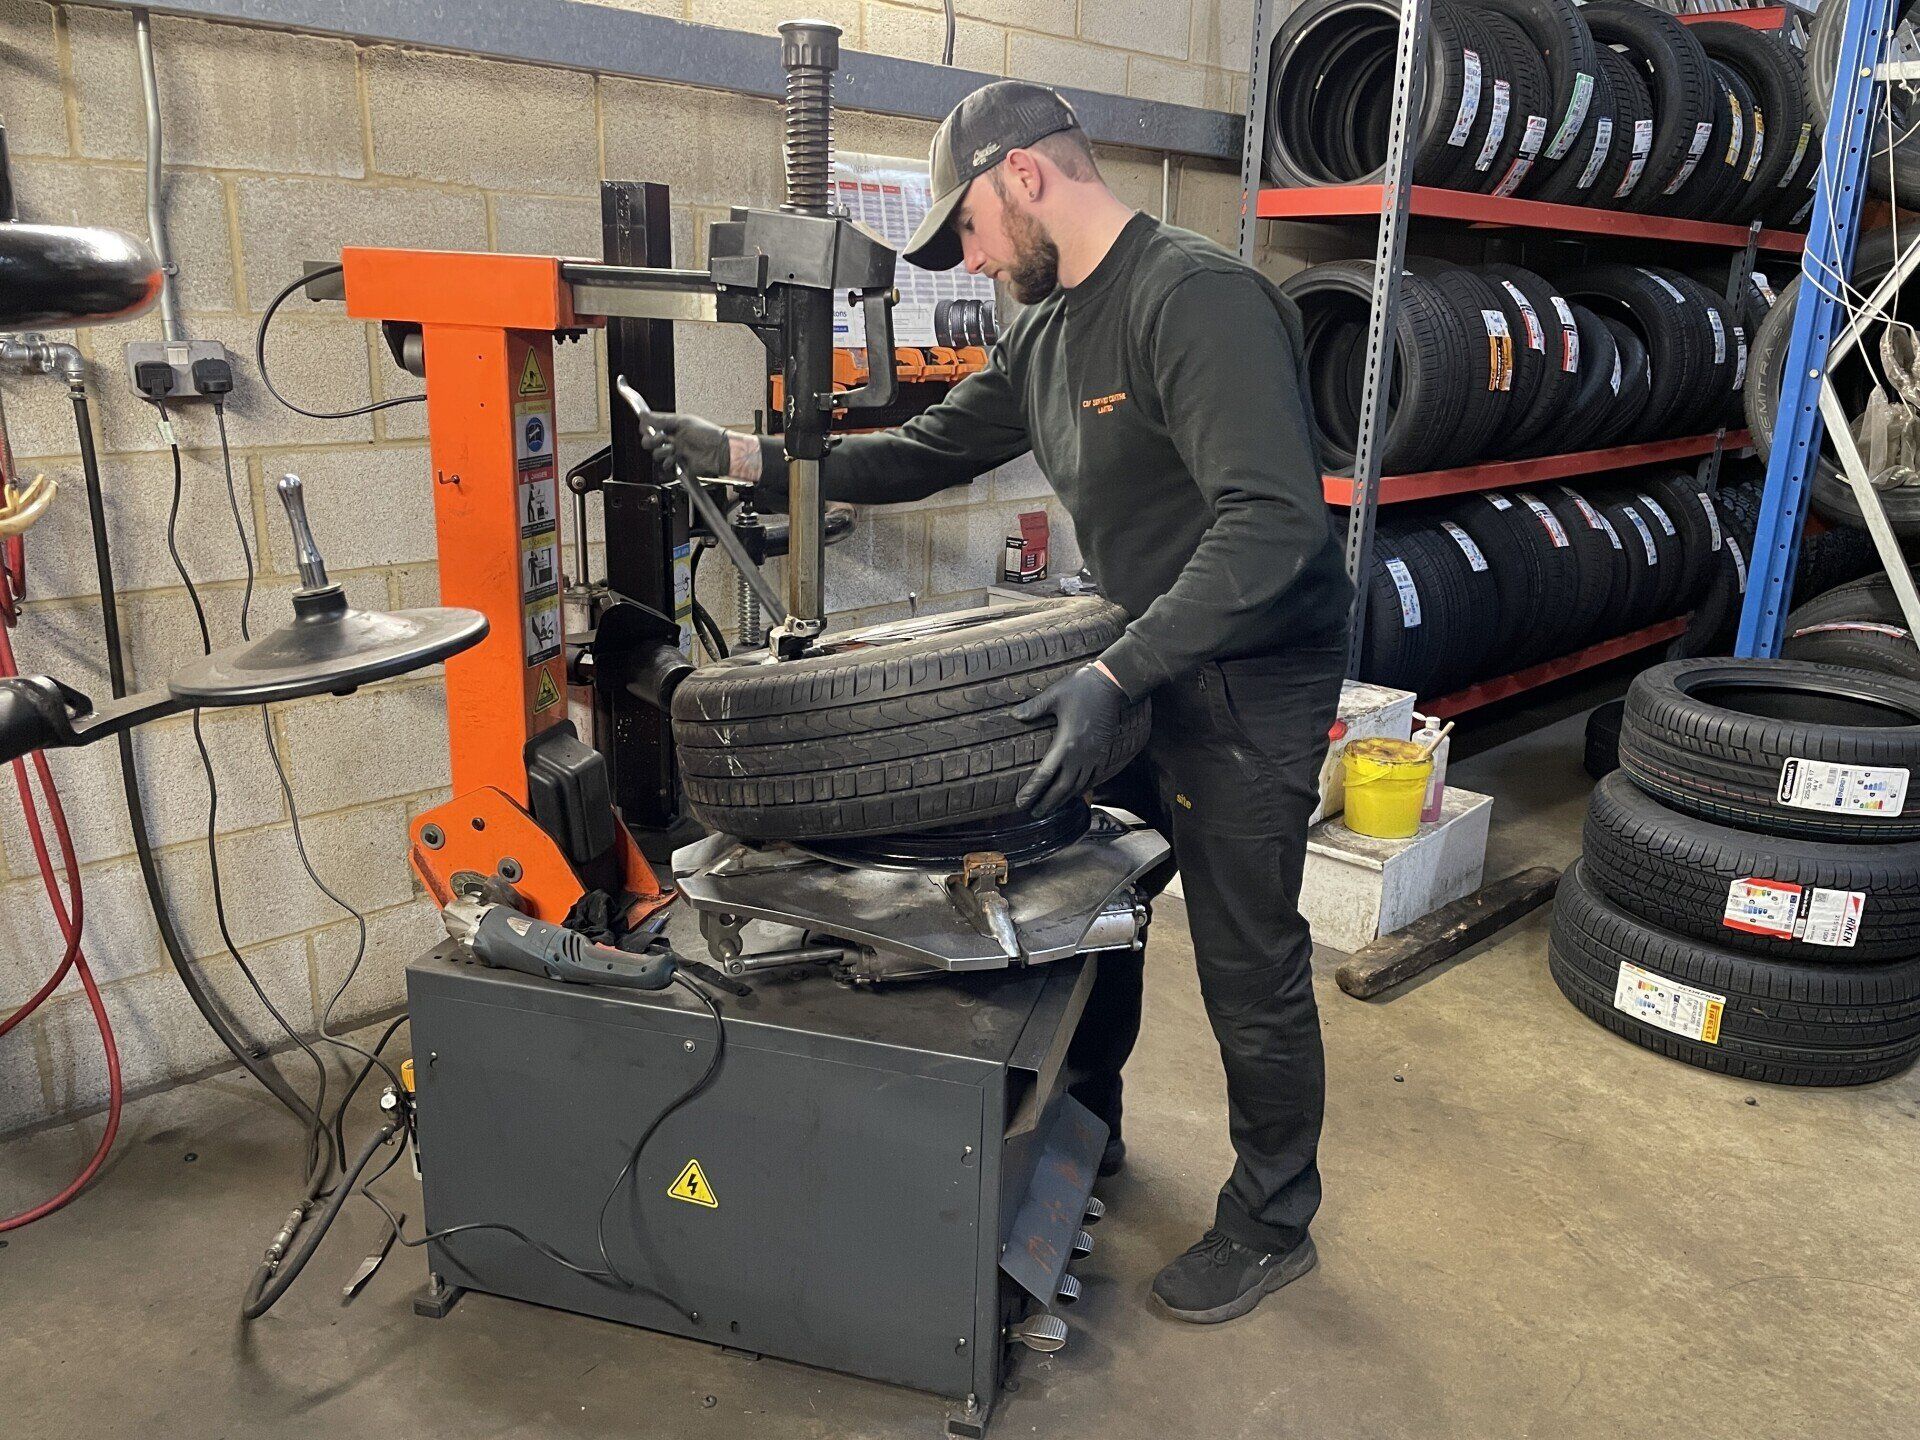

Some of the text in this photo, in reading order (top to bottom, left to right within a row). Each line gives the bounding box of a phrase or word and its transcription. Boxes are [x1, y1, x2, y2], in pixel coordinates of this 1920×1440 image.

[1758, 347, 1775, 447] REMITRA
[1842, 917, 1857, 943] RIKEN
[1705, 1003, 1722, 1040] PIRELLI
